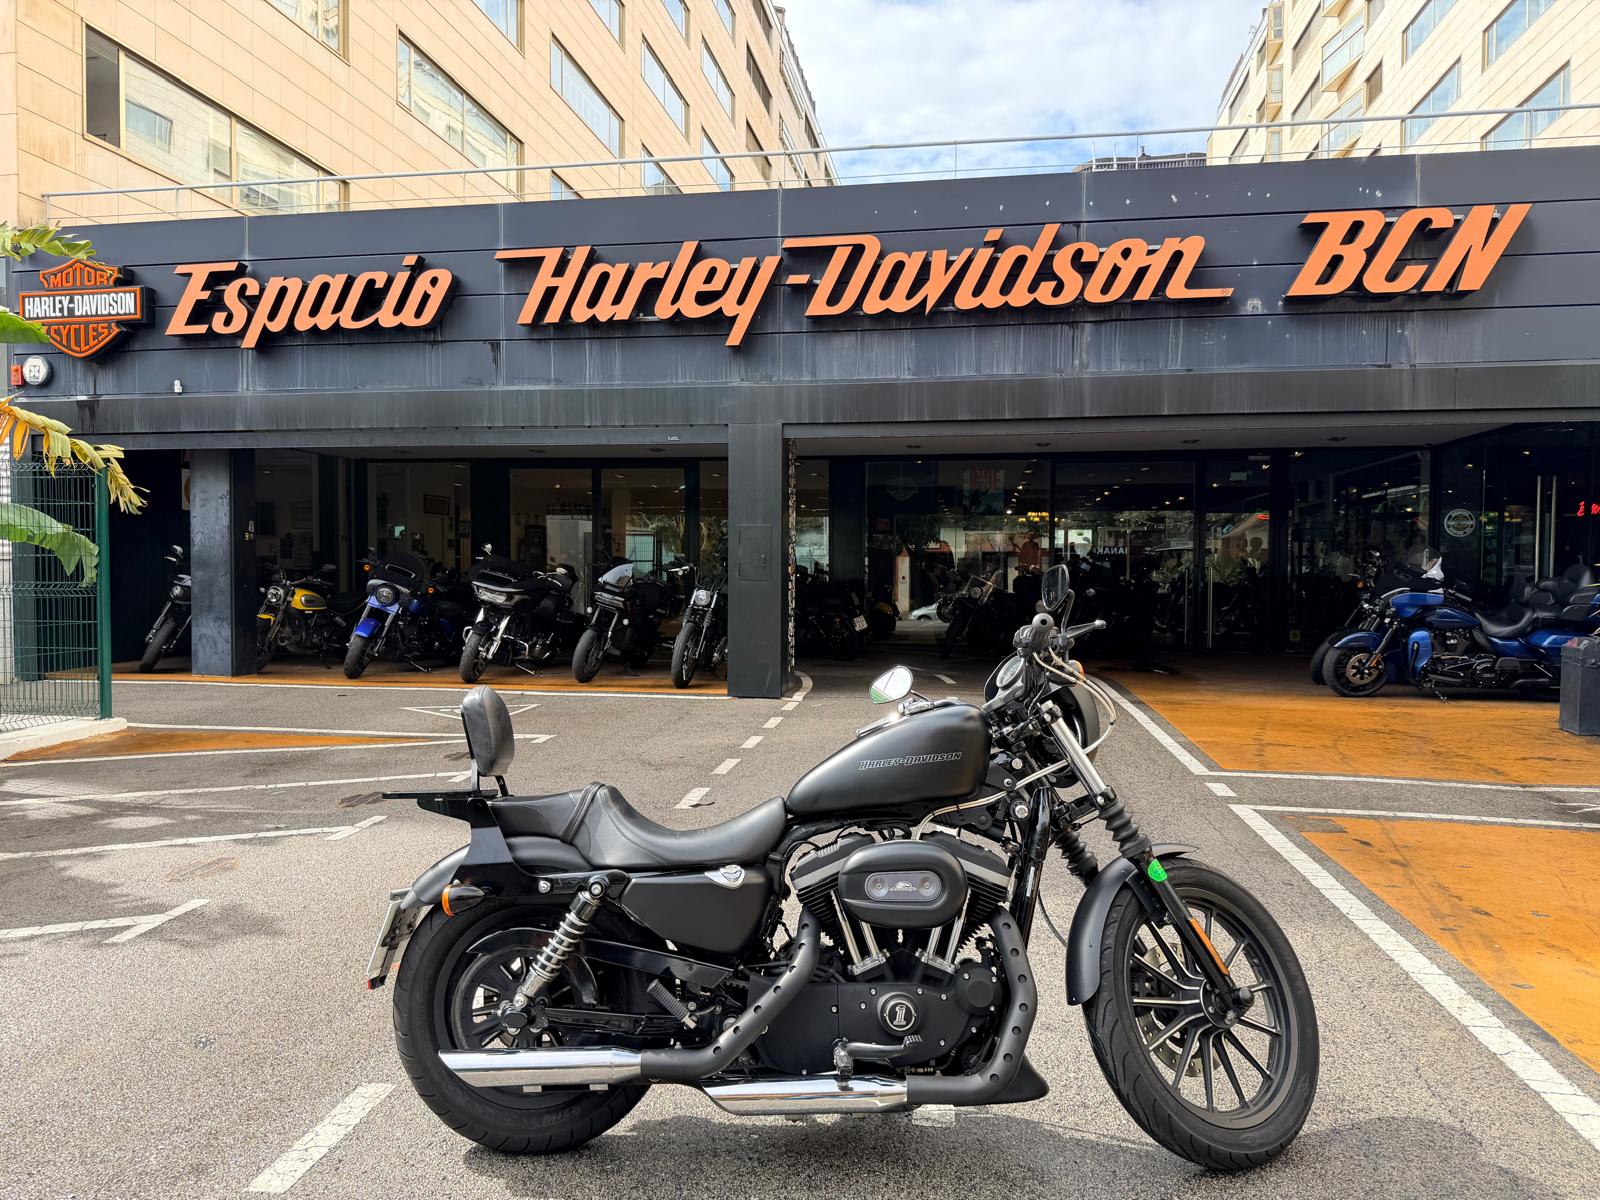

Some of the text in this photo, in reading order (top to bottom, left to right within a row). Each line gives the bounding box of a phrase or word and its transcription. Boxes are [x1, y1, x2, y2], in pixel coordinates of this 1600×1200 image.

[50, 263, 108, 288] MOTOR
[166, 203, 1532, 349] Espacio Harley-Davidson BCN
[25, 292, 135, 318] HARLEY-DAVIDSON
[50, 323, 109, 352] CYCLES
[858, 752, 962, 770] HARLEY-DAVIDSON
